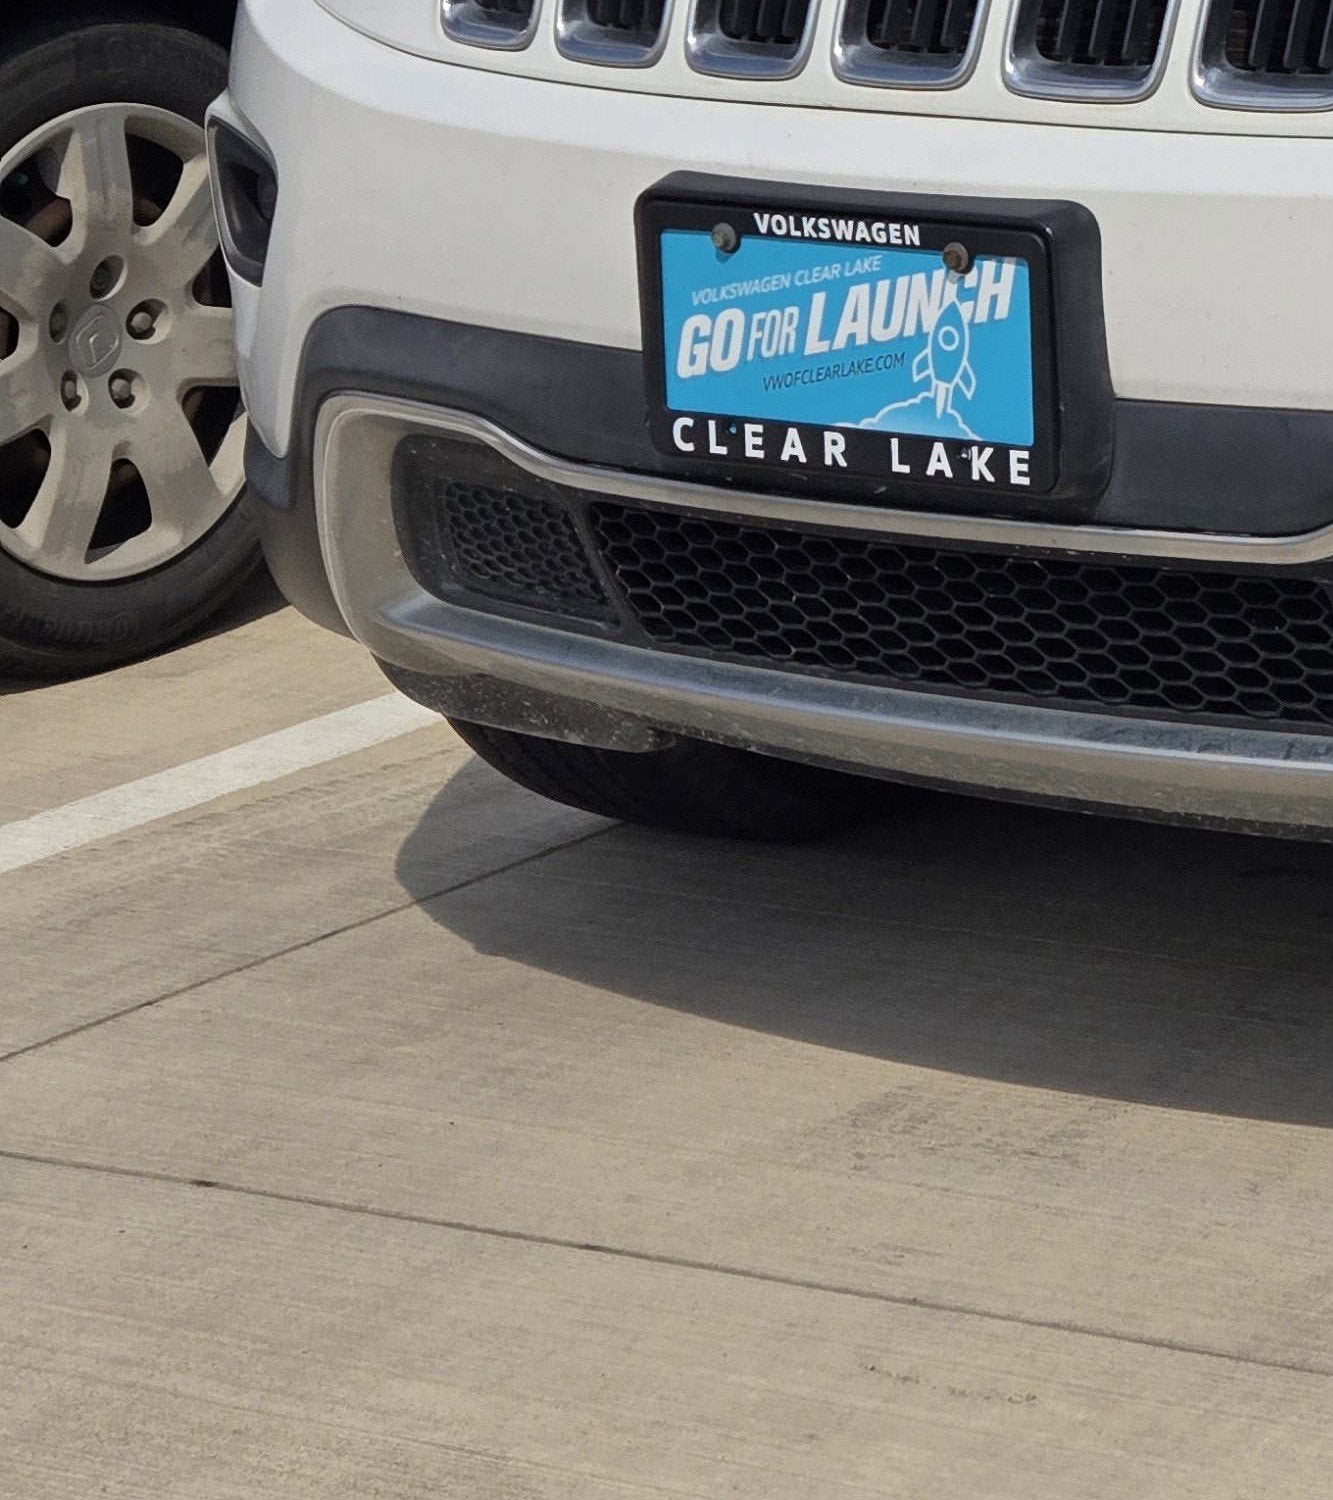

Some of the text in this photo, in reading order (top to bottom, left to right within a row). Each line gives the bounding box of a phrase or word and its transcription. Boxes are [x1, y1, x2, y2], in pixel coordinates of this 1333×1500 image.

[753, 212, 921, 246] VOLKSWAGEN
[691, 254, 883, 306] VOLKSWAGEN CLEAR LAKE
[676, 257, 1017, 379] GO FOR LAUNCH
[762, 352, 906, 392] VWOFCLEARLAKE.COM
[672, 416, 1032, 487] CLEAR LAKE
